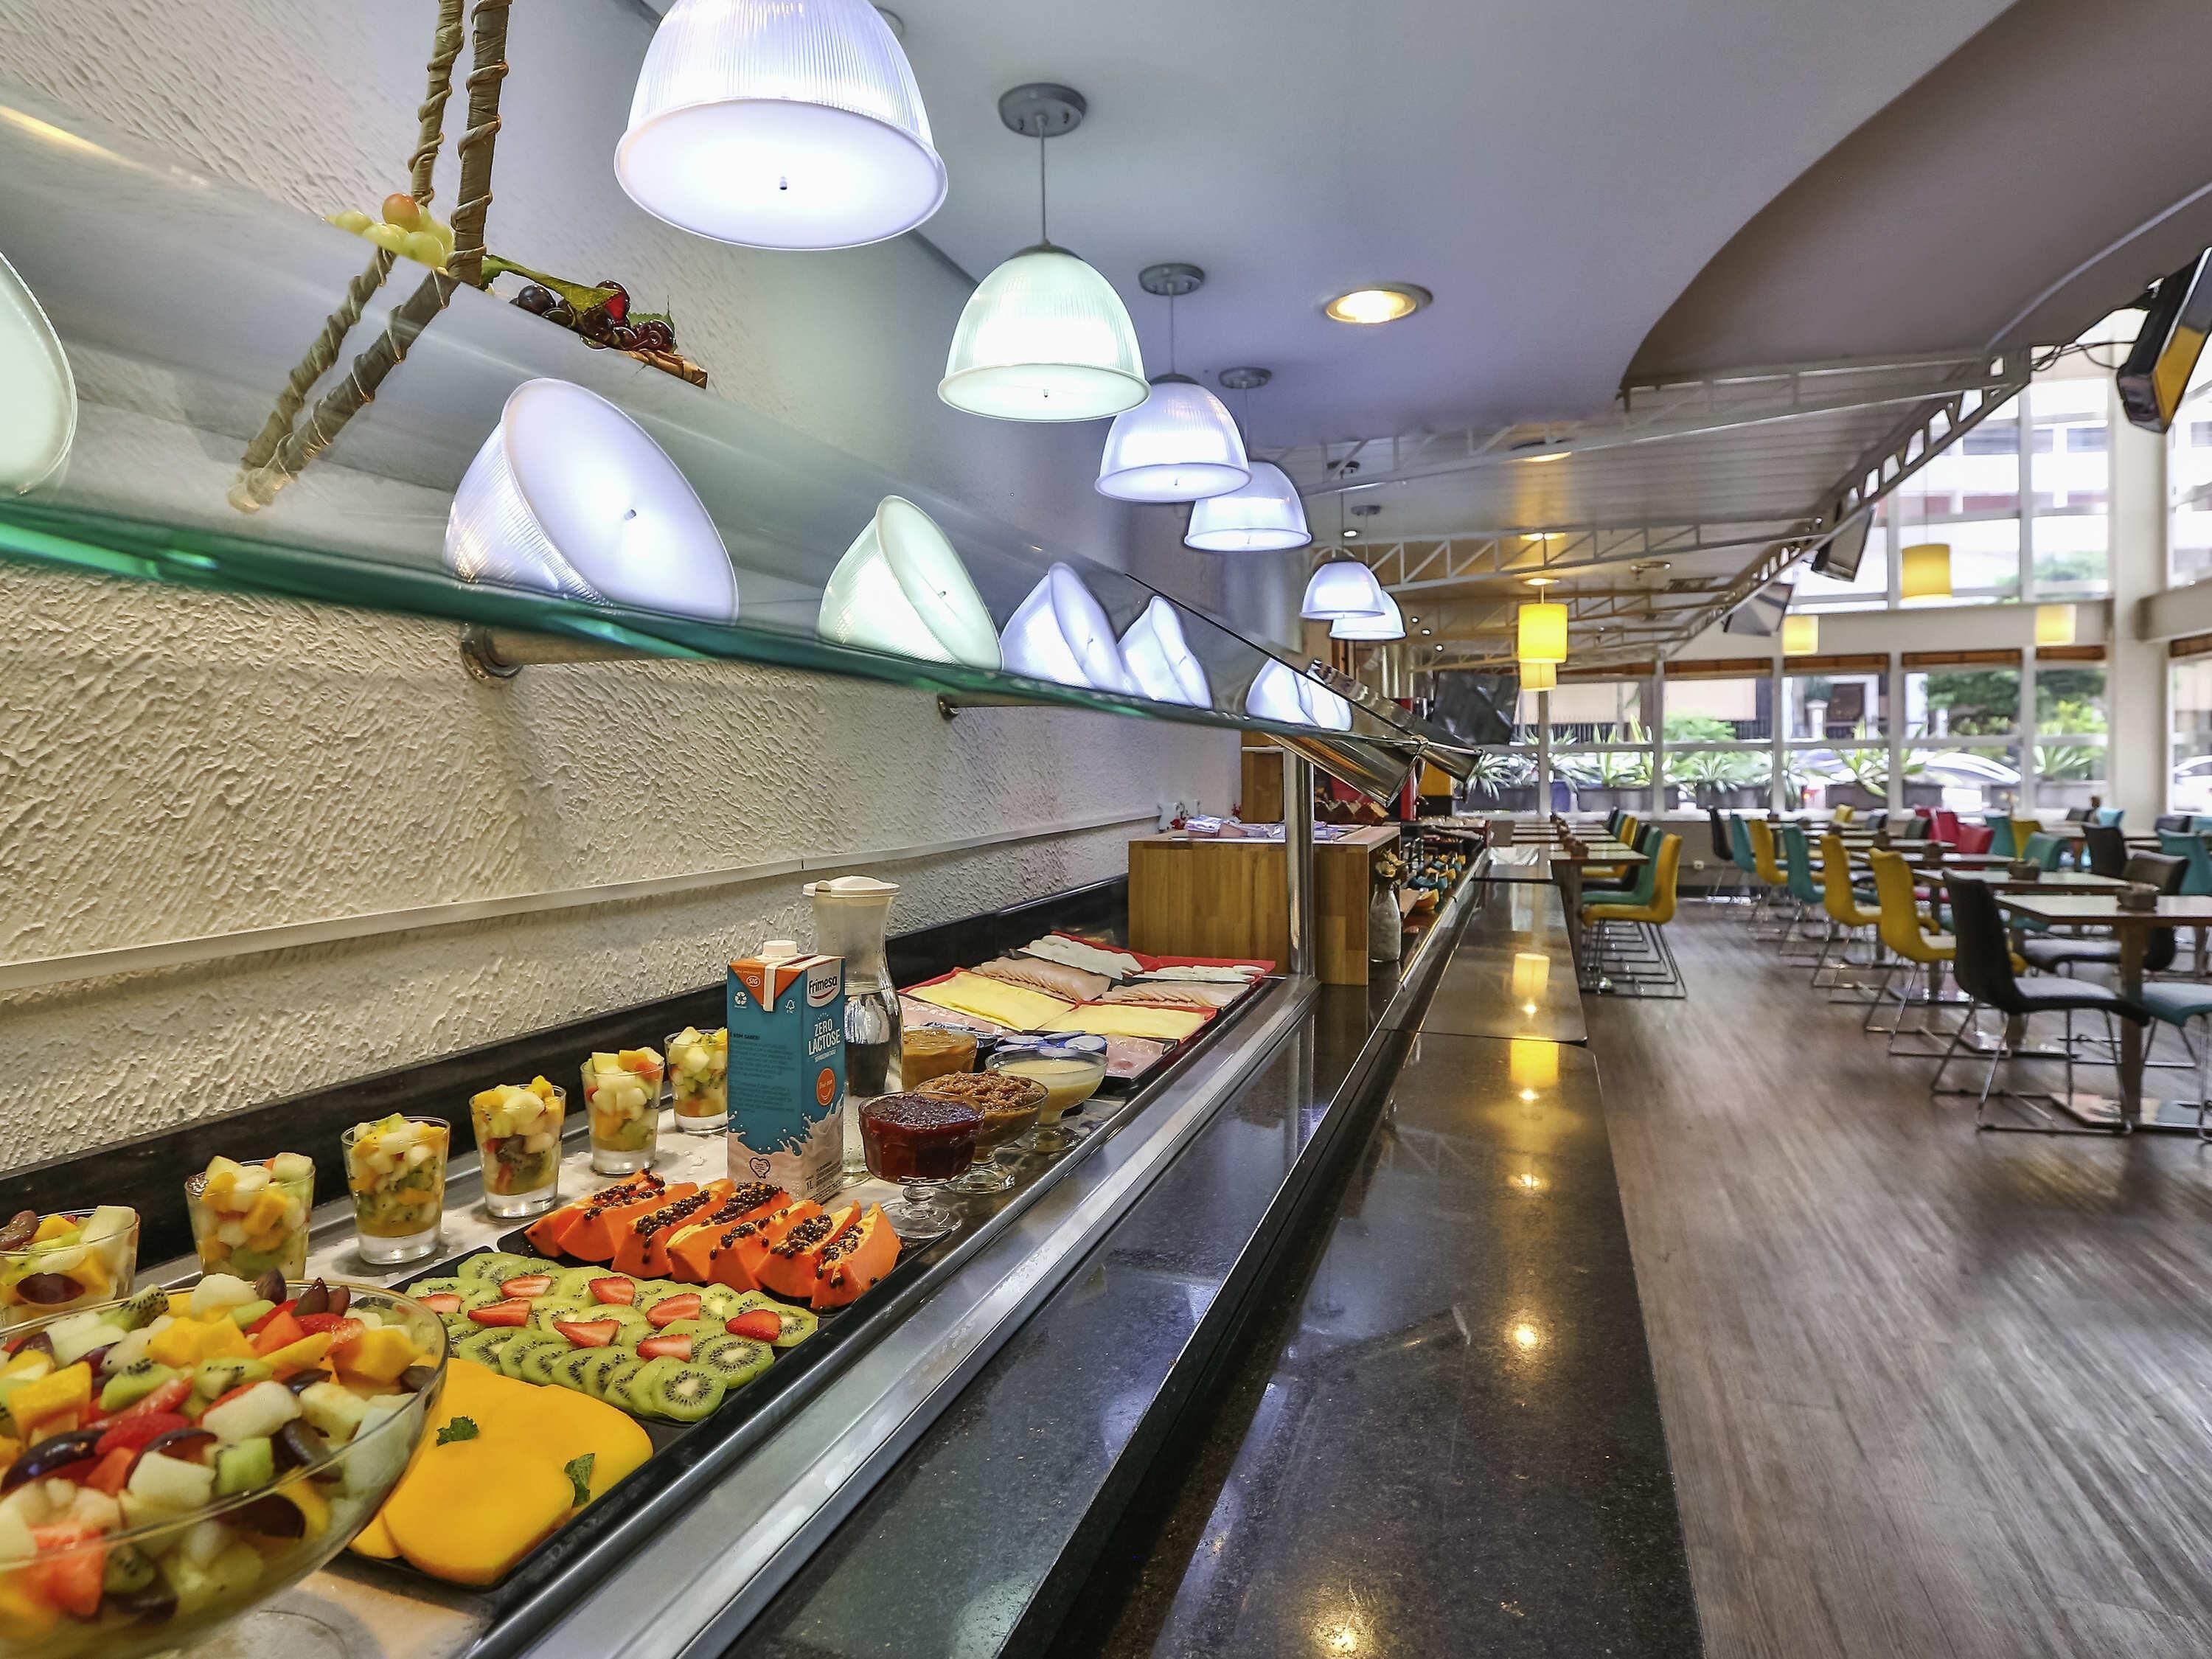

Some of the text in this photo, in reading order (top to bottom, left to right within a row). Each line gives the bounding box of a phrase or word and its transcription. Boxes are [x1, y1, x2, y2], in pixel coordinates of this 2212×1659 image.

[809, 976, 838, 994] Frimesa
[814, 1018, 832, 1037] ZERO
[808, 1029, 841, 1055] LACTOSE
